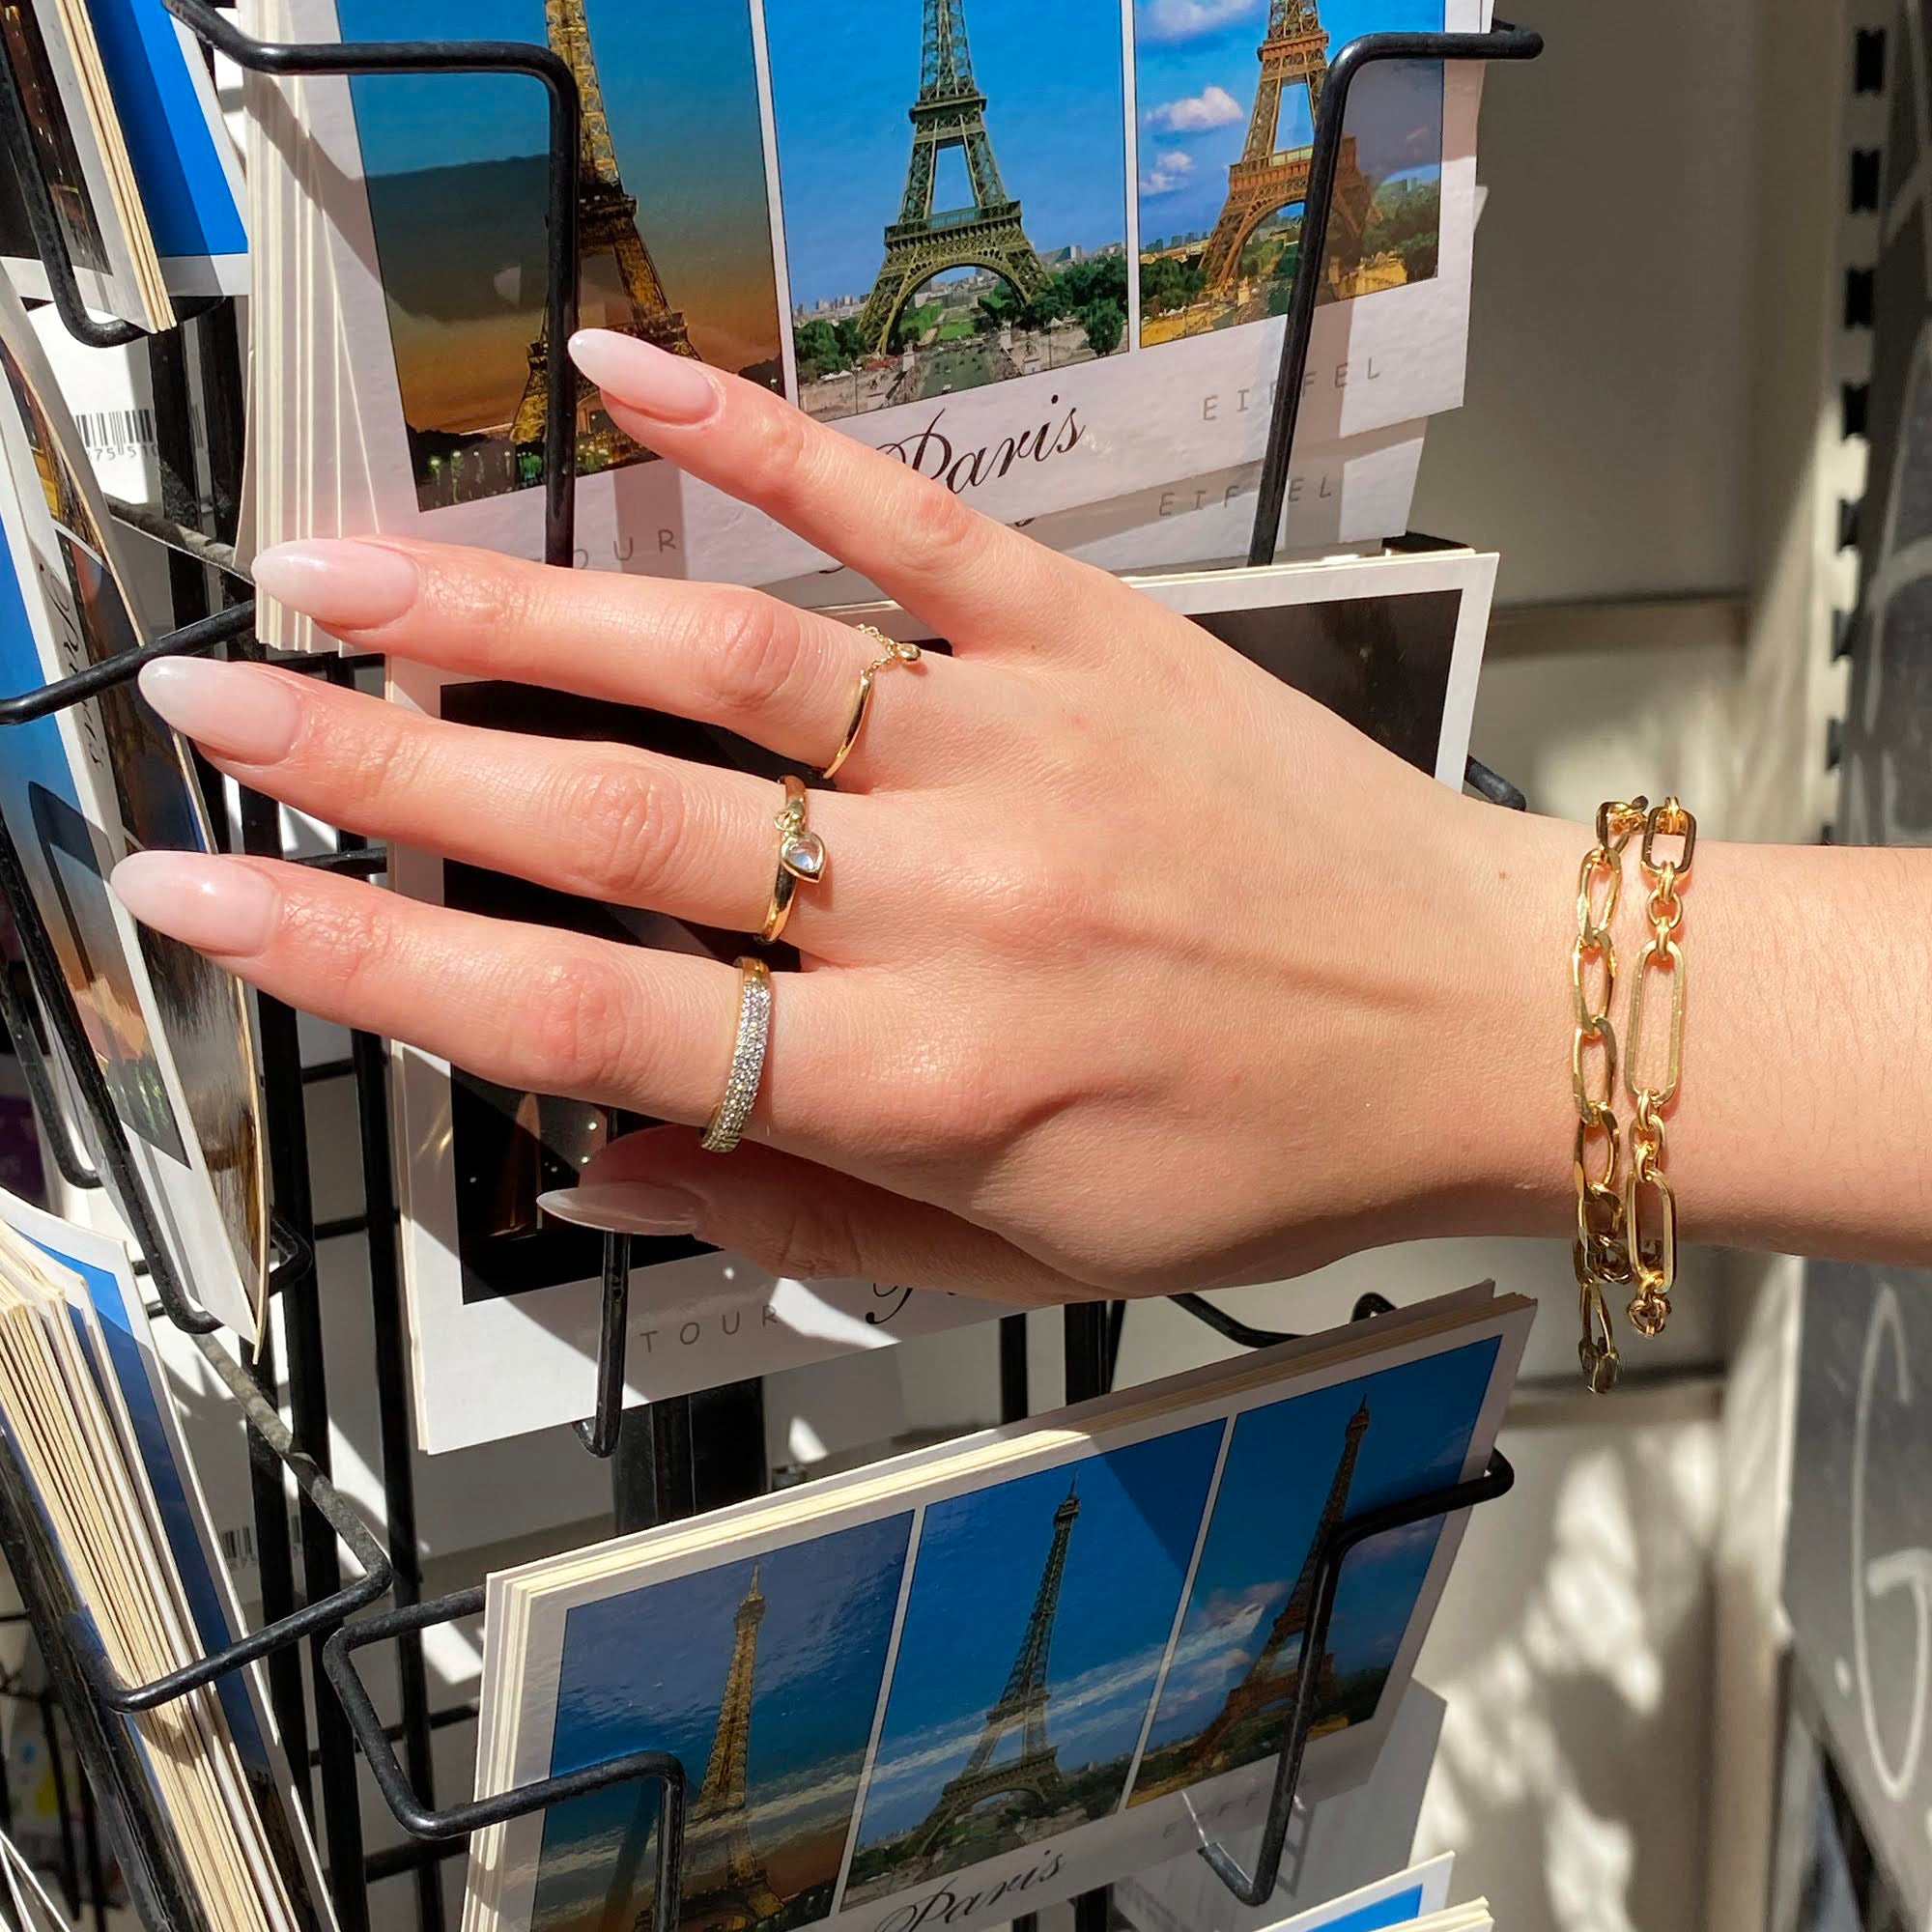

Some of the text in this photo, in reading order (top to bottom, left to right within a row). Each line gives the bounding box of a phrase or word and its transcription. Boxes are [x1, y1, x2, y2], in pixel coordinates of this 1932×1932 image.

[876, 394, 1086, 495] Paris
[1159, 473, 1332, 517] EIFEL
[639, 1305, 778, 1352] TOUR
[873, 1849, 1067, 1932] Paris
